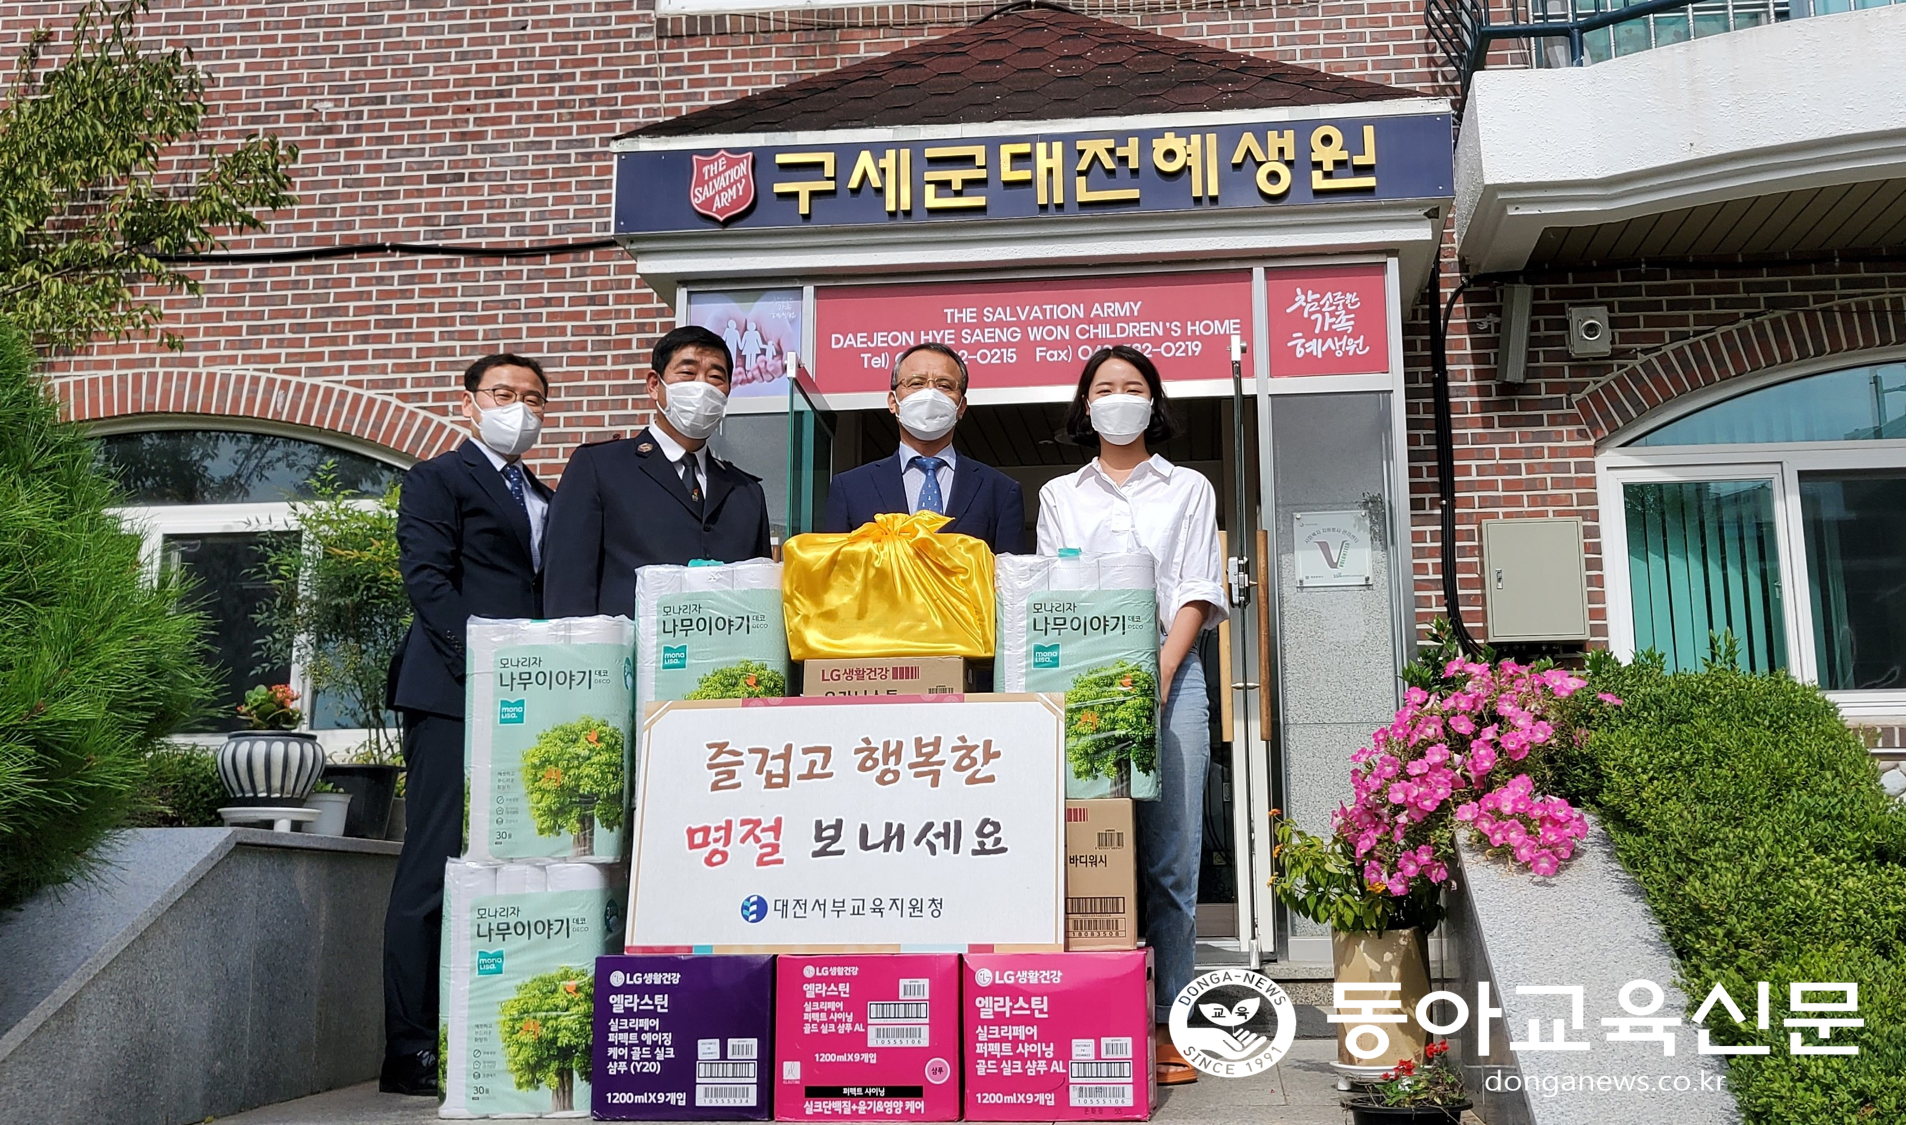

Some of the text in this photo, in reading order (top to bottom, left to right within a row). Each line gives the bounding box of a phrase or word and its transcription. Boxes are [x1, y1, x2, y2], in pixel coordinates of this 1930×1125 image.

[703, 157, 727, 180] THE
[774, 125, 1377, 216] 구세군대전혜생원
[694, 159, 747, 204] SALVATION
[712, 178, 745, 212] ARMY
[1286, 287, 1361, 318] 참 소중한
[944, 301, 1142, 323] THE SALVATION ARMY
[1310, 310, 1355, 334] 가족
[831, 319, 1241, 349] DAEJEON HYE SAENG WON CHILDREN'S HOME
[1287, 332, 1370, 358] 혜생원
[861, 353, 889, 369] Tel)
[1035, 345, 1072, 363] Fax)
[662, 603, 702, 617] 모나리자
[1032, 602, 1077, 614] 모나리자
[662, 615, 750, 638] 나무이야기
[1032, 614, 1126, 637] 나무이야기
[499, 656, 542, 669] 모나리자
[499, 669, 593, 692] 나무이야기
[821, 667, 889, 682] LG생활건강
[705, 734, 1001, 792] 즐겁고 행복한
[686, 816, 1009, 867] 명절 보내세요
[1069, 854, 1107, 868] 바디워시
[476, 906, 521, 920] 모나리자
[773, 896, 944, 919] 대전서부교육지원청
[476, 917, 587, 942] 나무이야기 데코
[626, 972, 681, 985] LG생활건강
[995, 970, 1062, 984] LG생활건강
[803, 982, 850, 998] 엘라스틴
[608, 994, 669, 1013] 엘라스틴
[803, 1001, 843, 1012] 실크리페어
[975, 996, 1049, 1019] 엘라스틴
[608, 1018, 659, 1031] 실크리페어
[803, 1012, 853, 1023] 퍼펙트 샤이닝
[803, 1023, 865, 1034] 골드 실크 샴푸 AL
[975, 1025, 1037, 1041] 실크리페어
[607, 1032, 672, 1046] 퍼펙트 에이징
[607, 1047, 675, 1060] 케어 골드 실크
[975, 1042, 1054, 1058] 퍼펙트 샤이닝
[607, 1061, 661, 1075] 샴푸 (Y20)
[931, 1067, 943, 1075] 샴푸
[975, 1060, 1067, 1076] 골드 실크 샴푸 AL
[843, 1087, 885, 1097] 퍼펙트 샤이닝
[904, 1100, 925, 1114] 케어
